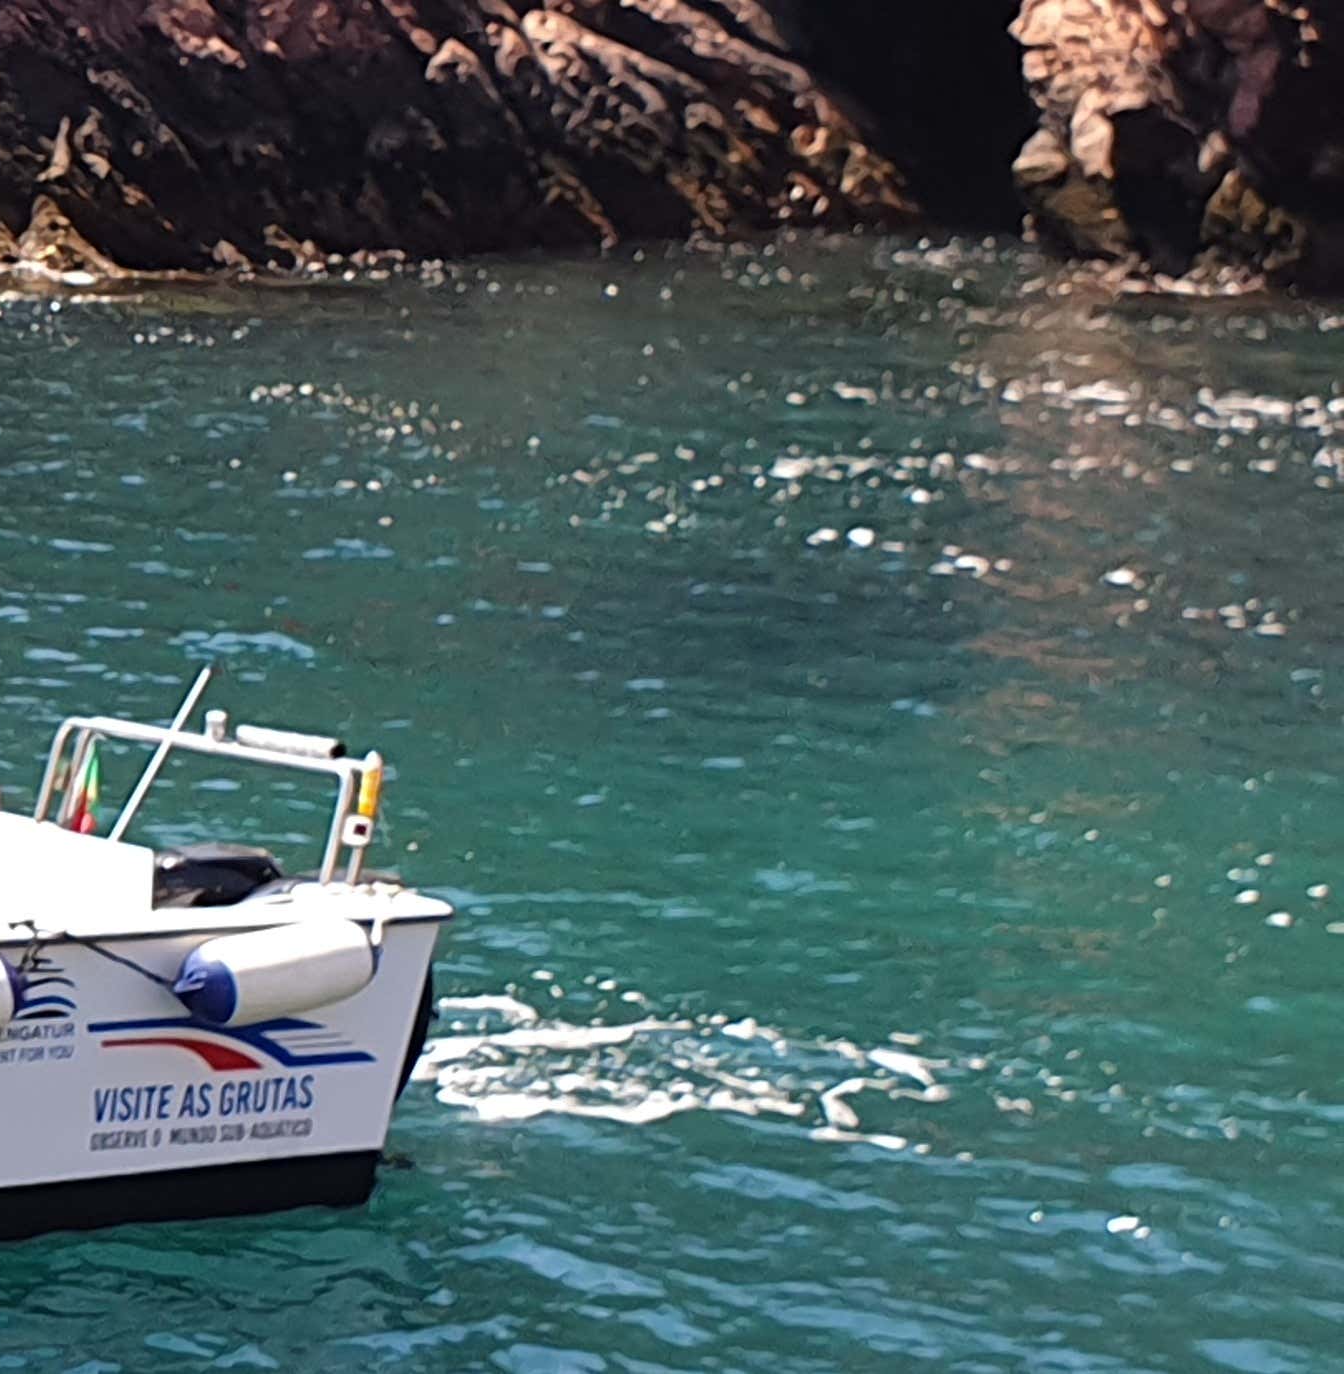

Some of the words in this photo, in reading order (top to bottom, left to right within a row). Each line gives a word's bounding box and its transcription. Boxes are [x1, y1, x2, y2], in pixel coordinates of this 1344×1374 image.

[18, 1047, 45, 1062] FOR
[49, 1045, 75, 1060] YOU
[94, 1085, 175, 1123] VISITE
[178, 1082, 214, 1119] AS
[218, 1074, 315, 1117] GRUTAS
[90, 1129, 148, 1150] OBSERVE
[168, 1125, 217, 1145] MUNDO
